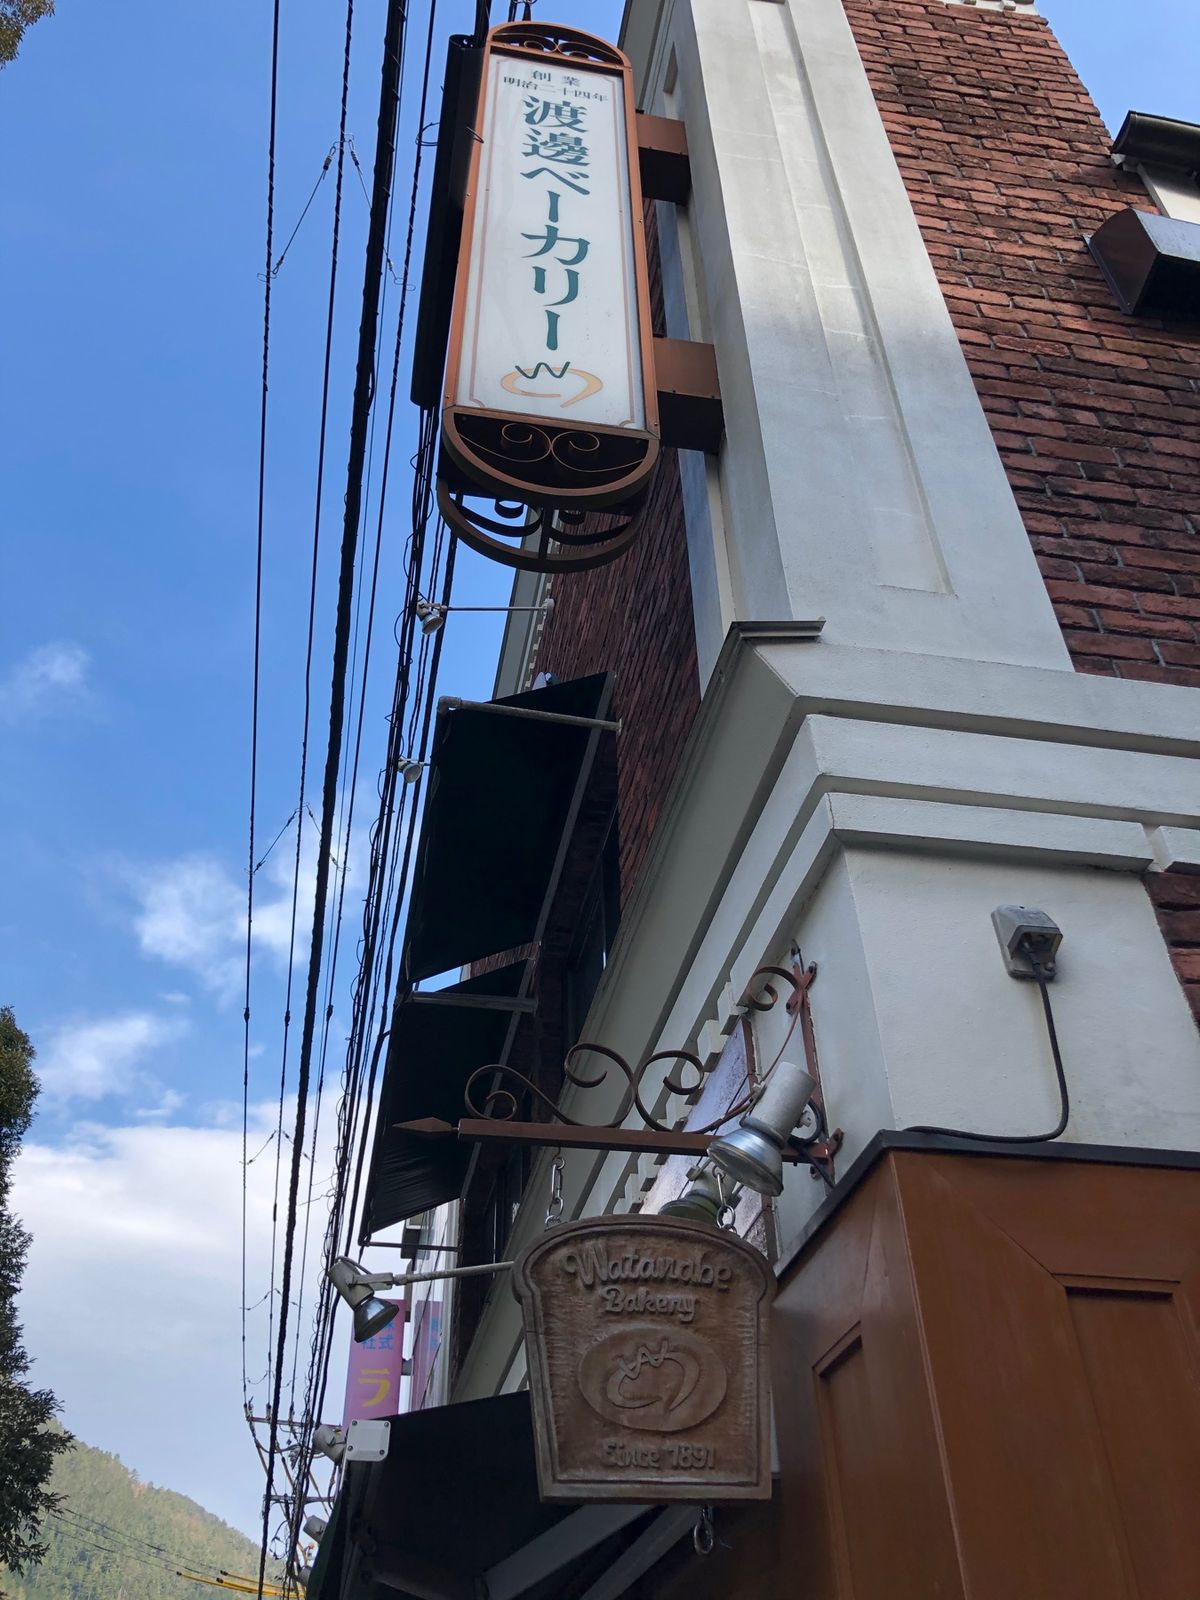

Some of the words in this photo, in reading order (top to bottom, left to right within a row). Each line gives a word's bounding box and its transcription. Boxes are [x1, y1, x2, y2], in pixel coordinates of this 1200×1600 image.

[503, 76, 609, 102] 明治二十四年
[564, 1245, 734, 1291] Watanabe
[602, 1285, 698, 1323] Bakery
[669, 1444, 716, 1470] 1891
